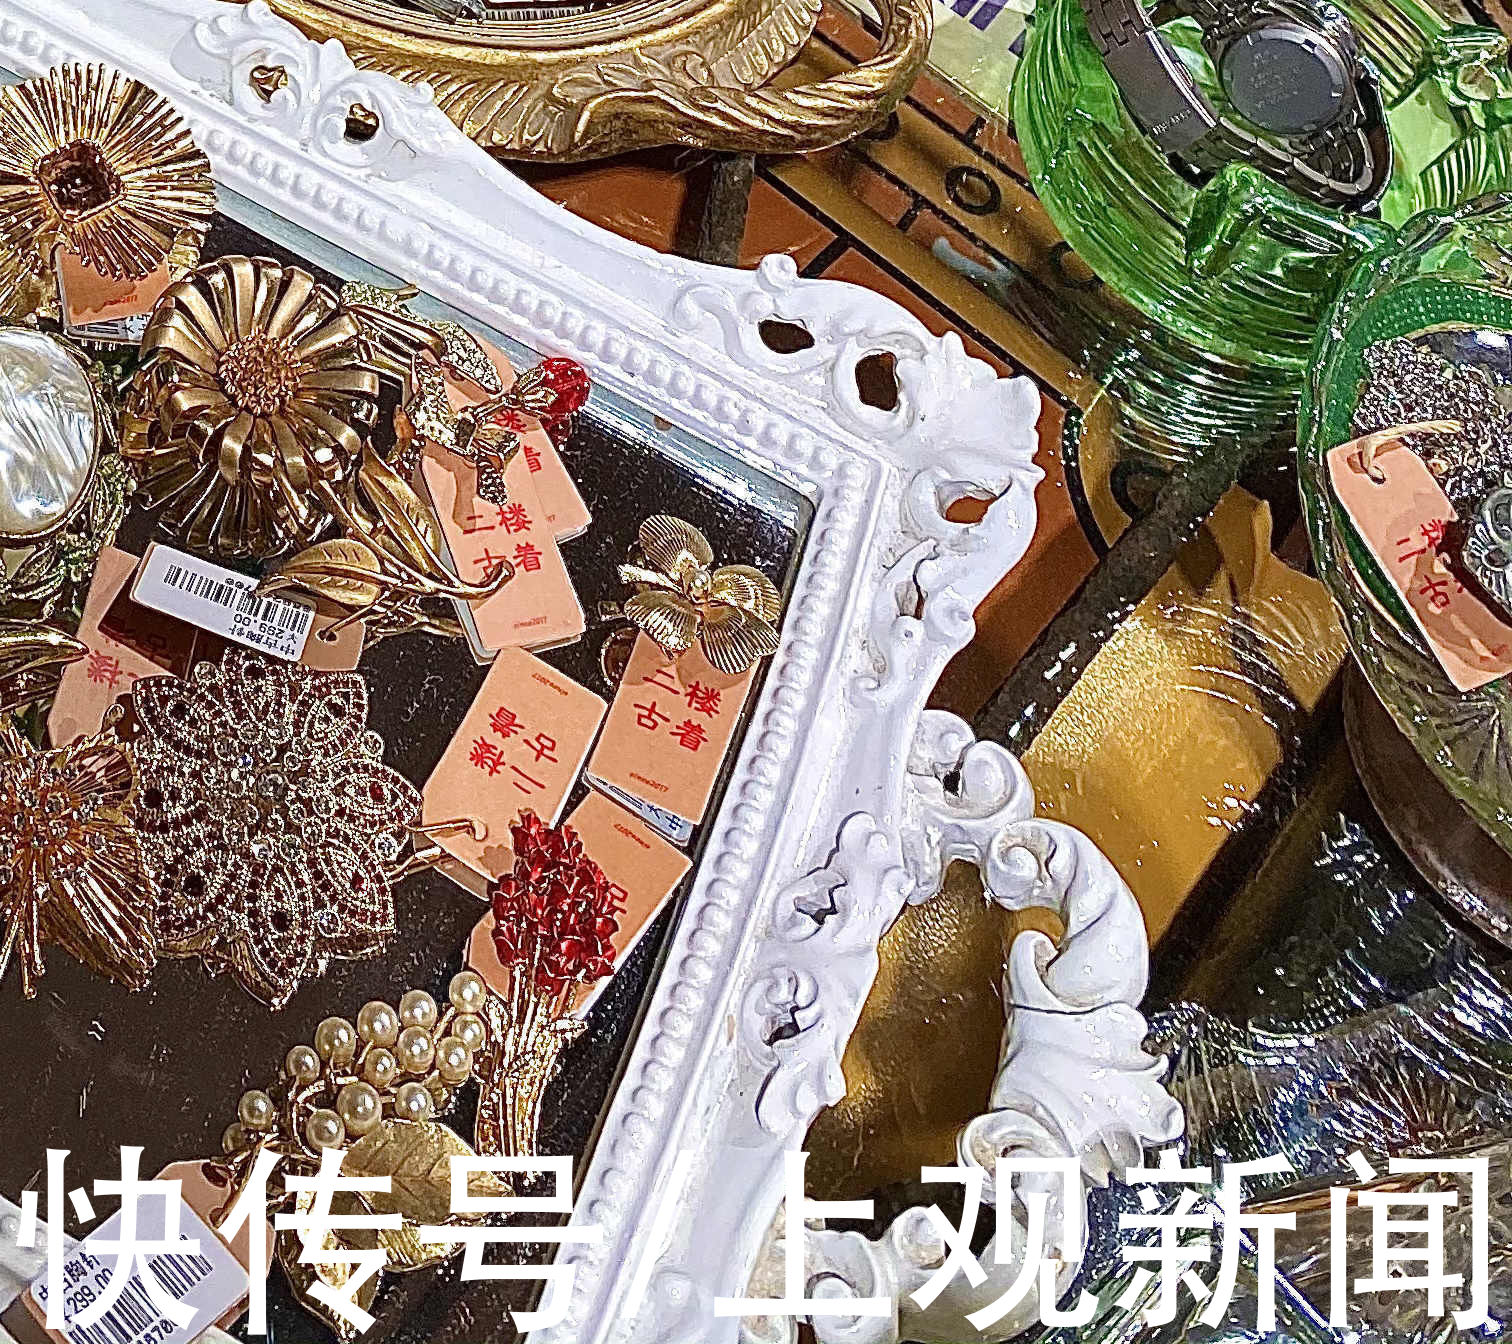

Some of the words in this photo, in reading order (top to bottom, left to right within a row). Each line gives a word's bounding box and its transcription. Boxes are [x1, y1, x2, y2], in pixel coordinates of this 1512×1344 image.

[463, 502, 533, 535] 二楼
[642, 667, 725, 720] 二楼
[488, 706, 559, 764] 古着
[633, 700, 712, 753] 古着
[468, 735, 548, 796] 二楼
